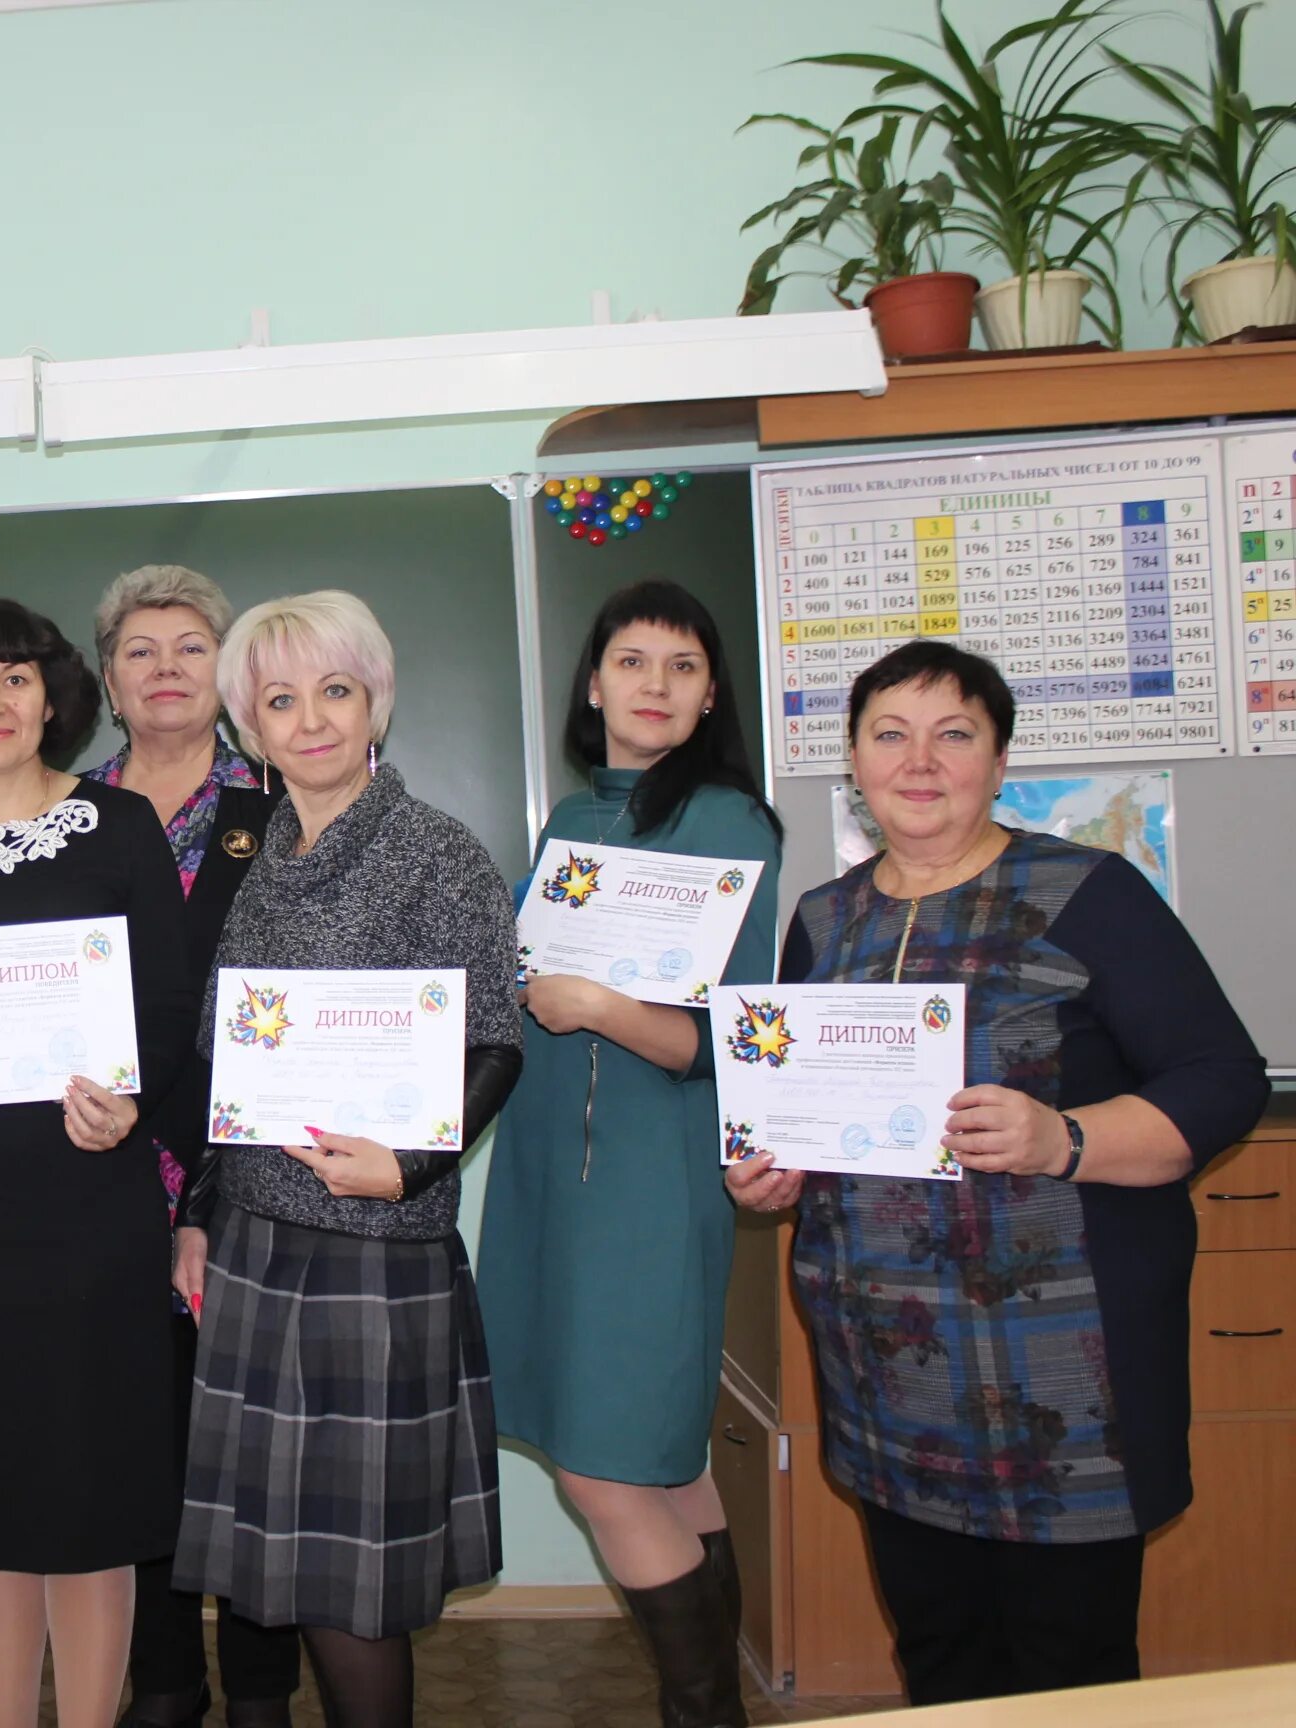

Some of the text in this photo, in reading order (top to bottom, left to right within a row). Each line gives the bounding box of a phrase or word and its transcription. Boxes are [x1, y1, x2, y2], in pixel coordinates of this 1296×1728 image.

[797, 456, 1200, 497] ТАБЛИЦА КВАДРАТОВ НАТУРАЛЬНЫХ ЧИСЕЛ ОТ 10 ДО 99
[1272, 481, 1282, 496] 2
[941, 490, 1052, 513] ЕДИНИЦЫ
[851, 527, 857, 541] 1
[890, 524, 899, 537] 2
[930, 521, 939, 535] 3
[970, 519, 980, 532] 4
[1012, 515, 1022, 529] 5
[1054, 513, 1064, 526] 6
[1096, 510, 1106, 523] 7
[1137, 506, 1149, 521] 8
[1181, 503, 1191, 517] 9
[1273, 508, 1282, 521] 4
[782, 528, 1200, 569] 1 100 121 144 169 196 225 256 289 324 361
[1275, 539, 1284, 551] 9
[783, 553, 1201, 593] 2 400 441 484 529 576 625 676 729 784 841
[1273, 569, 1290, 582] 16
[784, 577, 1207, 616] 3 900 961 1024 1089 1156 1225 1296 1369 1444 1521
[1274, 599, 1291, 612] 25
[784, 602, 1207, 640] 4 1600 1681 1764 1849 1936 2025 2116 2209 2304 2401
[786, 650, 795, 664] 5
[804, 648, 837, 662] 2500
[844, 646, 875, 659] 2601
[966, 639, 999, 651] 2916
[1006, 636, 1040, 650] 3025
[1048, 634, 1082, 647] 3136
[1090, 632, 1124, 645] 3249
[1131, 629, 1166, 643] 3364
[1174, 627, 1209, 640] 3481
[1274, 629, 1293, 642] 36
[787, 674, 797, 687] 6
[805, 672, 837, 685] 3600
[1007, 660, 1042, 673] 4225
[1049, 658, 1083, 671] 4356
[1091, 655, 1126, 668] 4489
[1133, 654, 1168, 667] 4624
[1176, 651, 1210, 664] 4761
[1277, 659, 1294, 672] 49
[806, 696, 839, 708] 4900
[1050, 683, 1085, 695] 5776
[1092, 680, 1127, 693] 5929
[1177, 676, 1212, 689] 6241
[1278, 690, 1296, 702] 64
[790, 701, 1213, 734] 8 6400 225 7396 7569 7744 7921
[1279, 720, 1296, 732] 81
[791, 725, 1215, 758] 9 8100 9025 9216 9409 9604 9801
[618, 881, 710, 904] ДИПЛОМ
[315, 1010, 413, 1030] ДИПЛОМ
[818, 1025, 916, 1046] ДИПЛОМ
